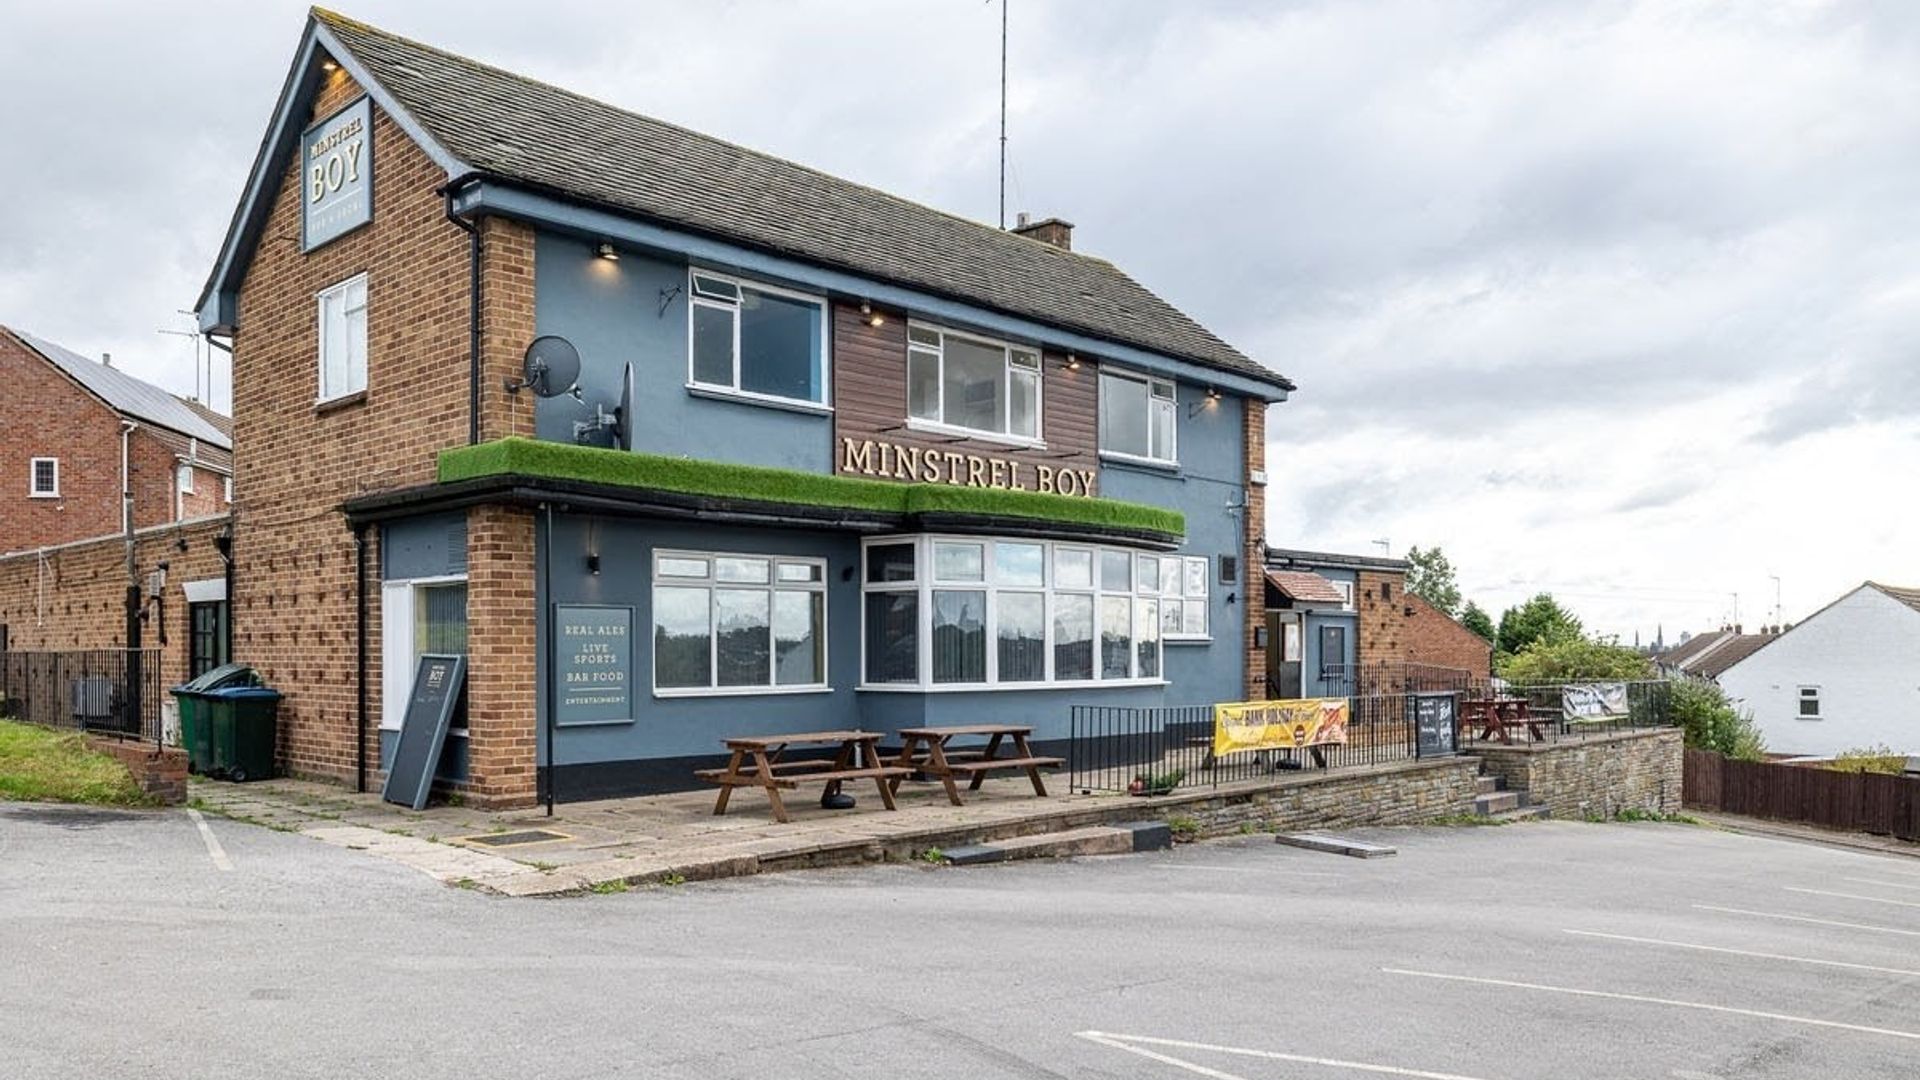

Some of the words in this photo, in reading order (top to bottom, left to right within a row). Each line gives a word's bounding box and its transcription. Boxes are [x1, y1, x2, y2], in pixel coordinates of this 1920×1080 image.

[310, 117, 363, 160] MINSTREL
[311, 140, 363, 204] BOY
[843, 437, 1025, 492] MINSTREL
[1035, 465, 1096, 498] BOY
[565, 625, 594, 635] REAL
[598, 625, 625, 636] ALES
[582, 643, 609, 653] LIVE
[574, 654, 616, 664] SPORTS
[566, 672, 589, 682] BAR
[593, 671, 624, 682] FOOD
[565, 696, 625, 705] ENTERTAINMENT
